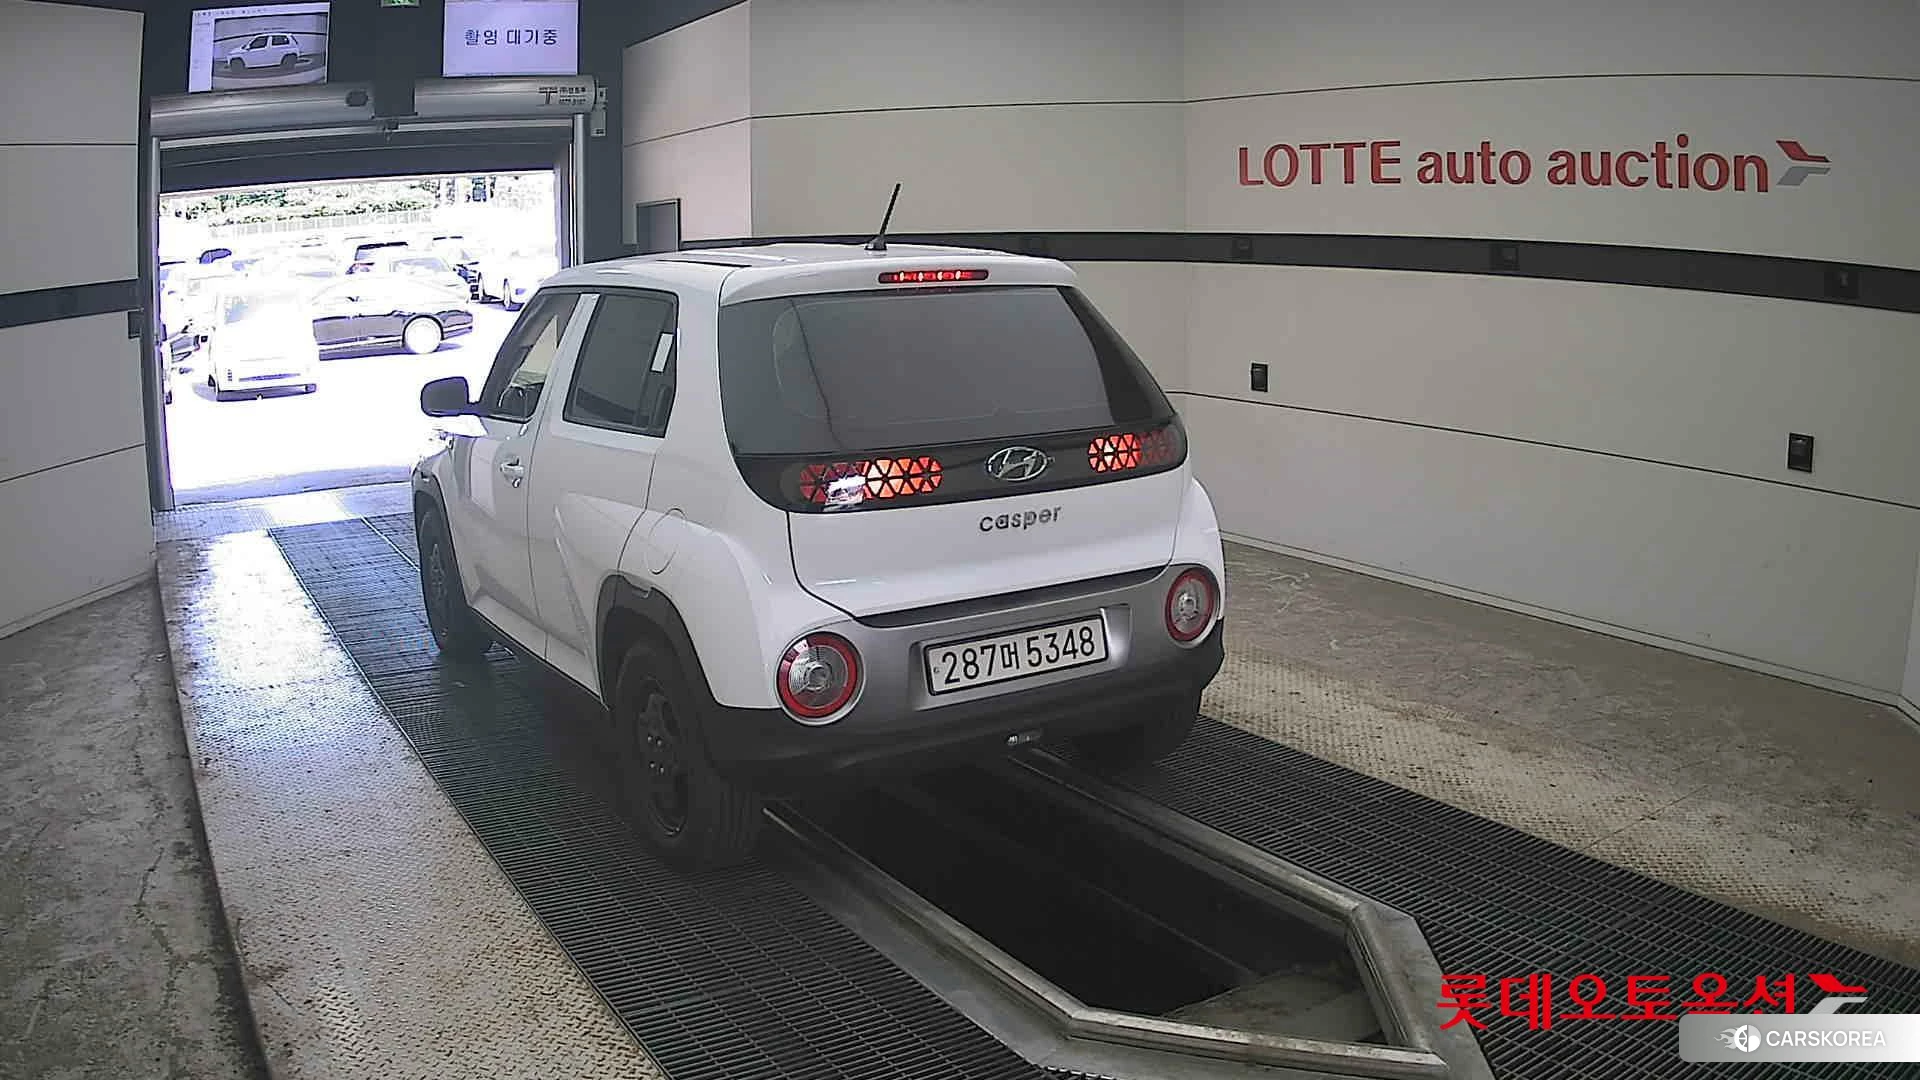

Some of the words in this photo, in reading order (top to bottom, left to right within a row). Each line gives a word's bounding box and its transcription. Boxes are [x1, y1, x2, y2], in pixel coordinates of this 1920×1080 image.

[506, 29, 558, 46] 대기중
[1239, 140, 1401, 187] LOTTE
[1416, 141, 1531, 185] auto
[1547, 133, 1768, 192] auction
[979, 506, 1062, 532] casper
